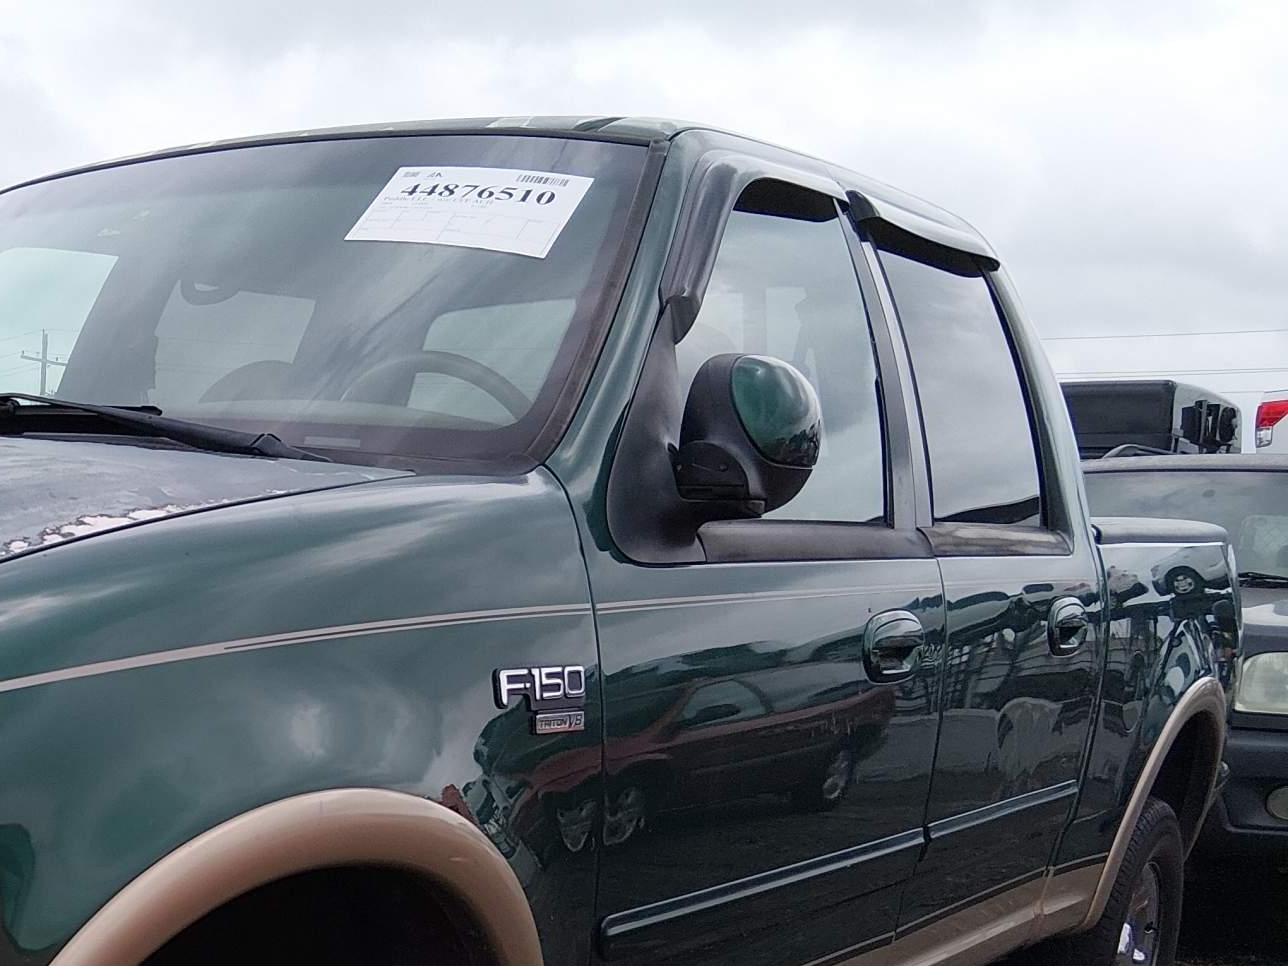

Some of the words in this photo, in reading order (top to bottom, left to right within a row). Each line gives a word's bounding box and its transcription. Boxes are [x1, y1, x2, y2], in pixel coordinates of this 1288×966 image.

[400, 183, 556, 206] 44876510
[498, 665, 585, 706] F-150
[539, 717, 568, 729] TRITON
